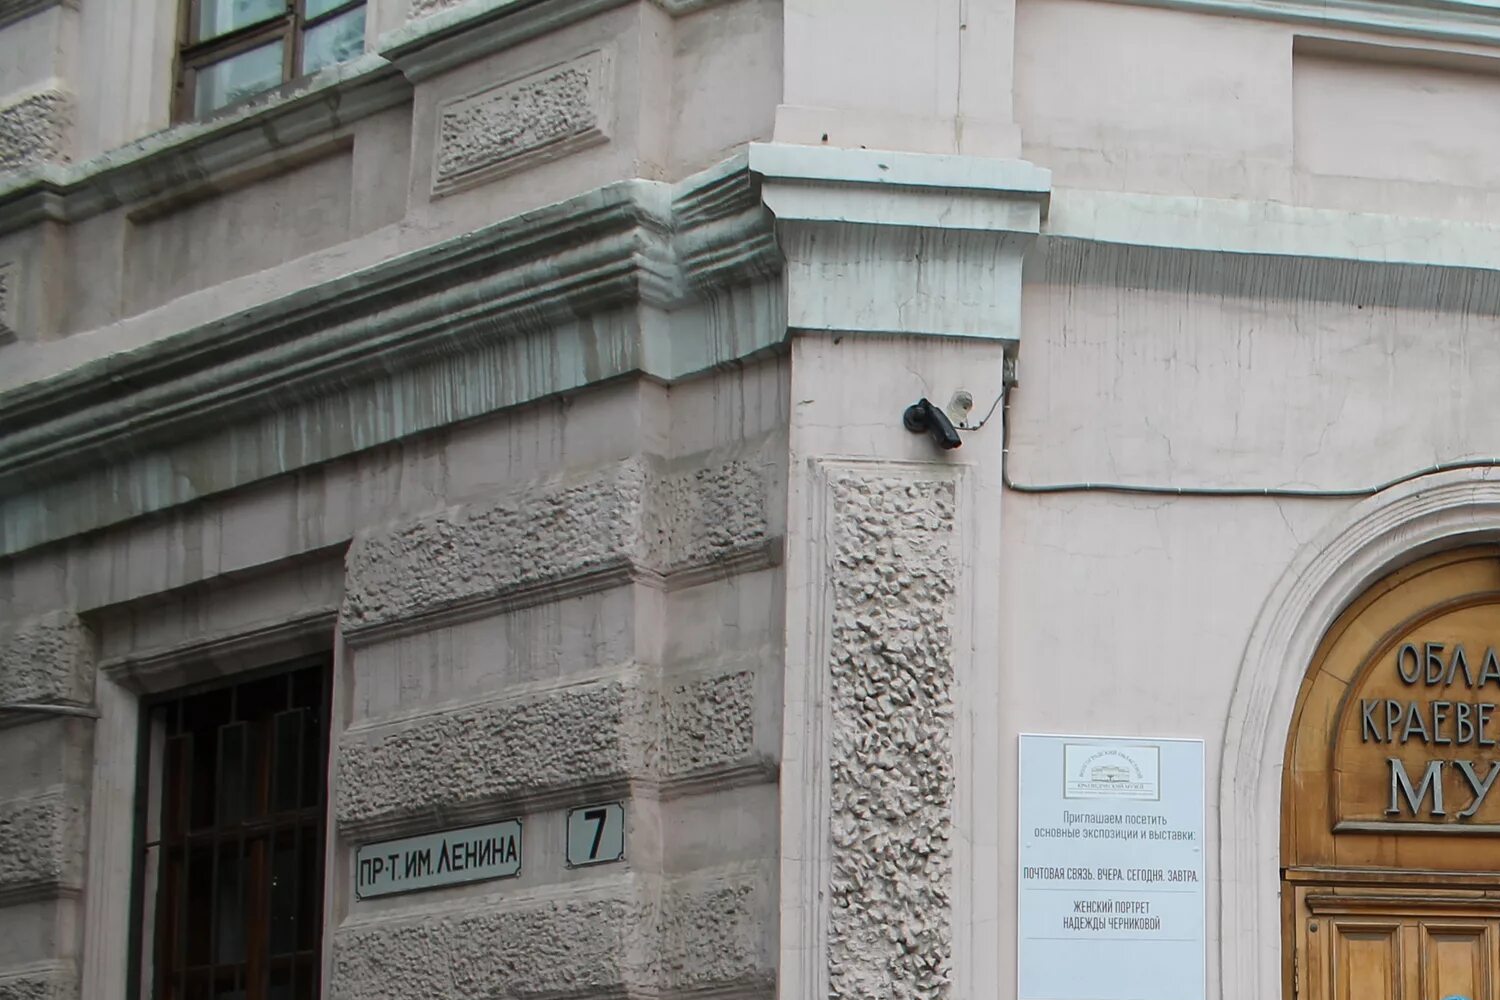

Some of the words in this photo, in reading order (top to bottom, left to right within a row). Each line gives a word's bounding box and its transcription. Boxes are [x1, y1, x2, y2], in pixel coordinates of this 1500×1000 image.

[1063, 810, 1122, 826] Приглашаем
[1125, 814, 1167, 825] посетить
[584, 808, 607, 860] 7
[1034, 827, 1081, 838] основные
[1082, 828, 1138, 841] экспозиции
[1140, 829, 1146, 839] и
[1149, 830, 1196, 841] выставки:
[437, 834, 518, 873] ЛЕНИНА
[1023, 867, 1064, 880] ПОЧТОВАЯ
[1067, 868, 1095, 880] СВЯЗЬ.
[1097, 868, 1124, 881] ВЧЕРА.
[1127, 869, 1165, 883] СЕГОДНЯ.
[1167, 870, 1199, 882] ЗАВТРА.
[1073, 899, 1113, 914] ЖЕНСКИЙ
[1115, 901, 1150, 914] ПОРТРЕТ
[1063, 916, 1106, 931] НАДЕЖДЫ
[1108, 916, 1160, 930] ЧЕРНИКОВОЙ
